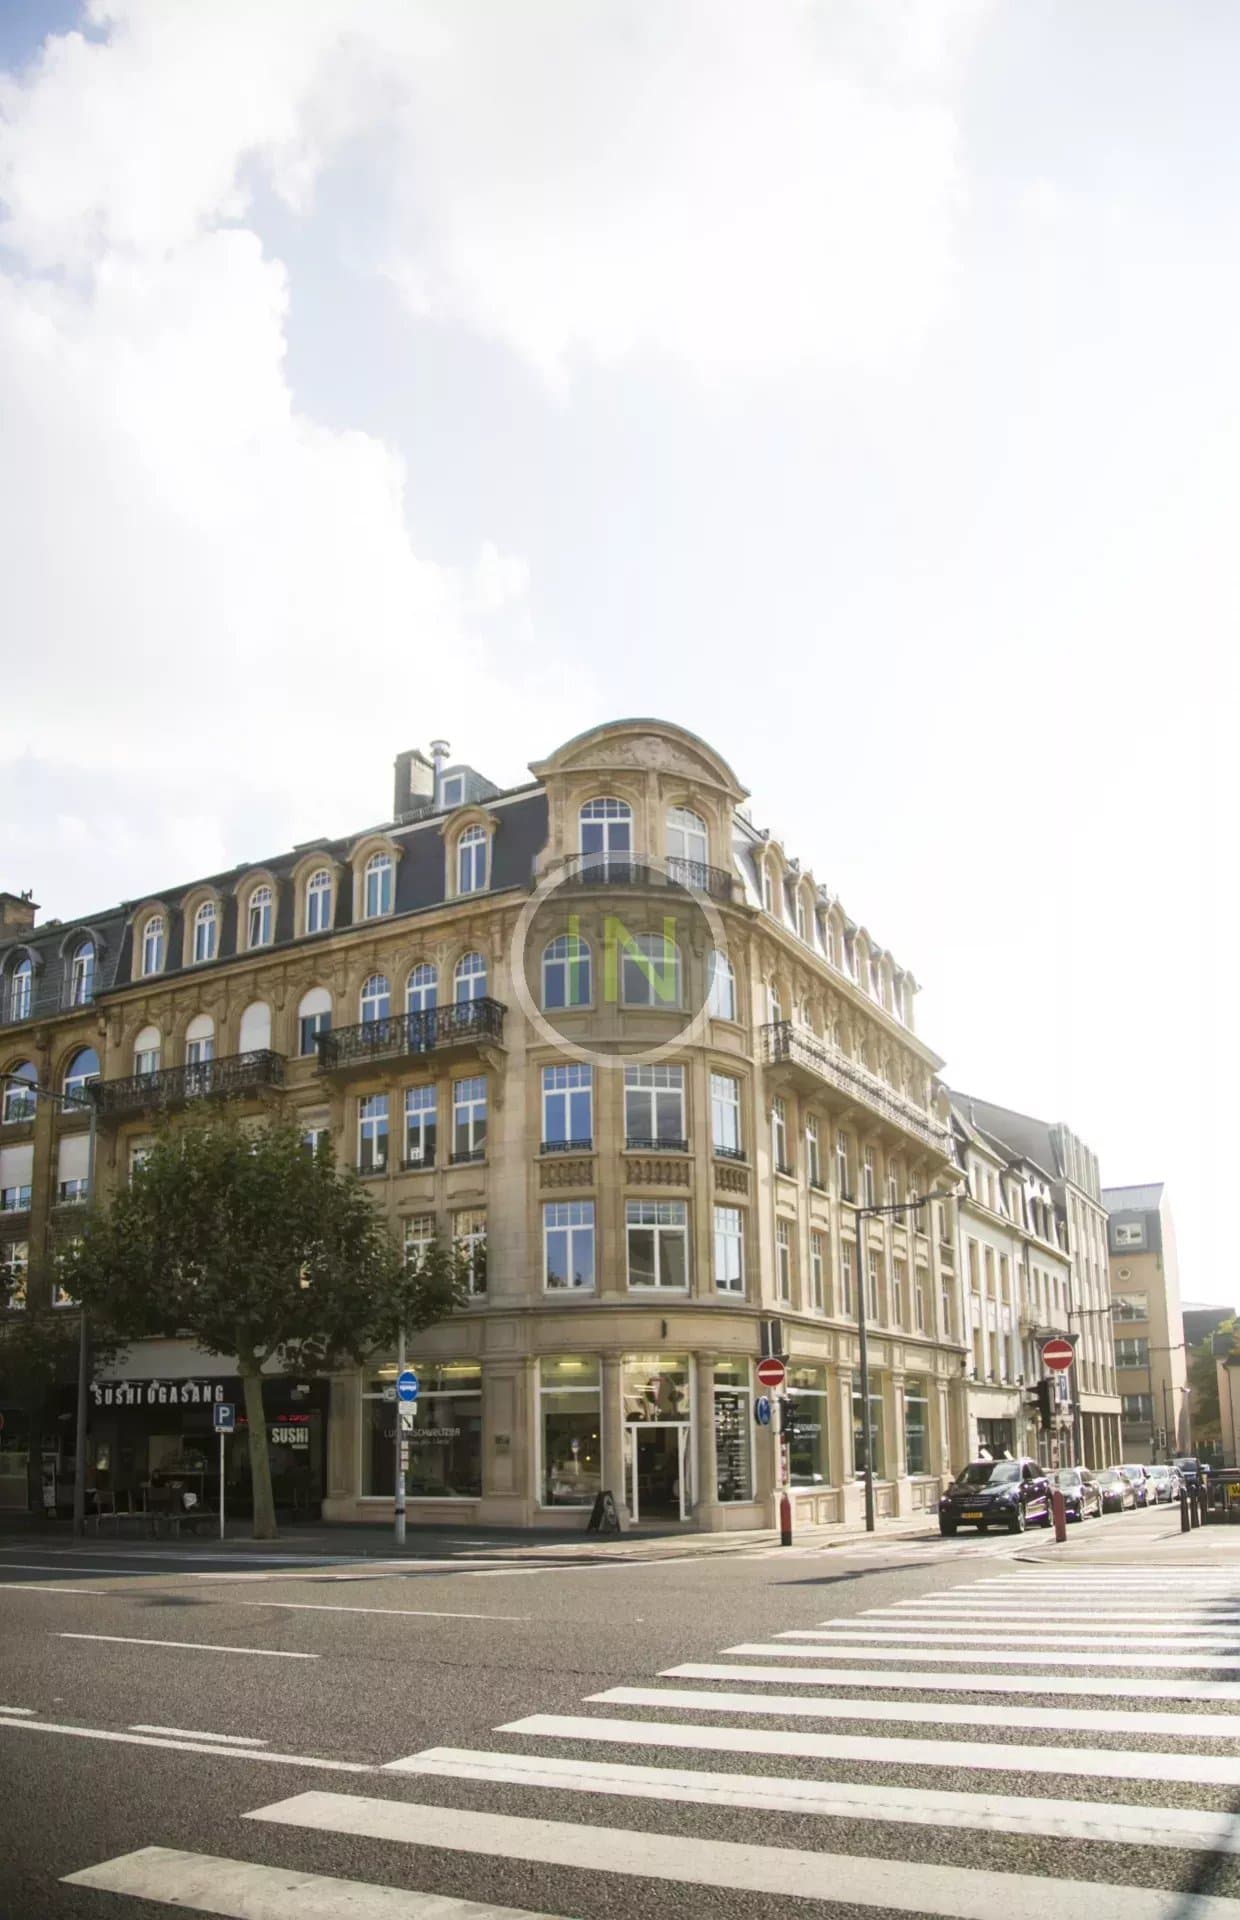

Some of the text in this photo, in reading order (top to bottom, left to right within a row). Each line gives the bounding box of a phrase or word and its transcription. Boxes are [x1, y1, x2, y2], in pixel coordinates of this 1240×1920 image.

[95, 1387, 142, 1406] SUSHI
[218, 1406, 230, 1424] P
[271, 1427, 308, 1443] SUSHI
